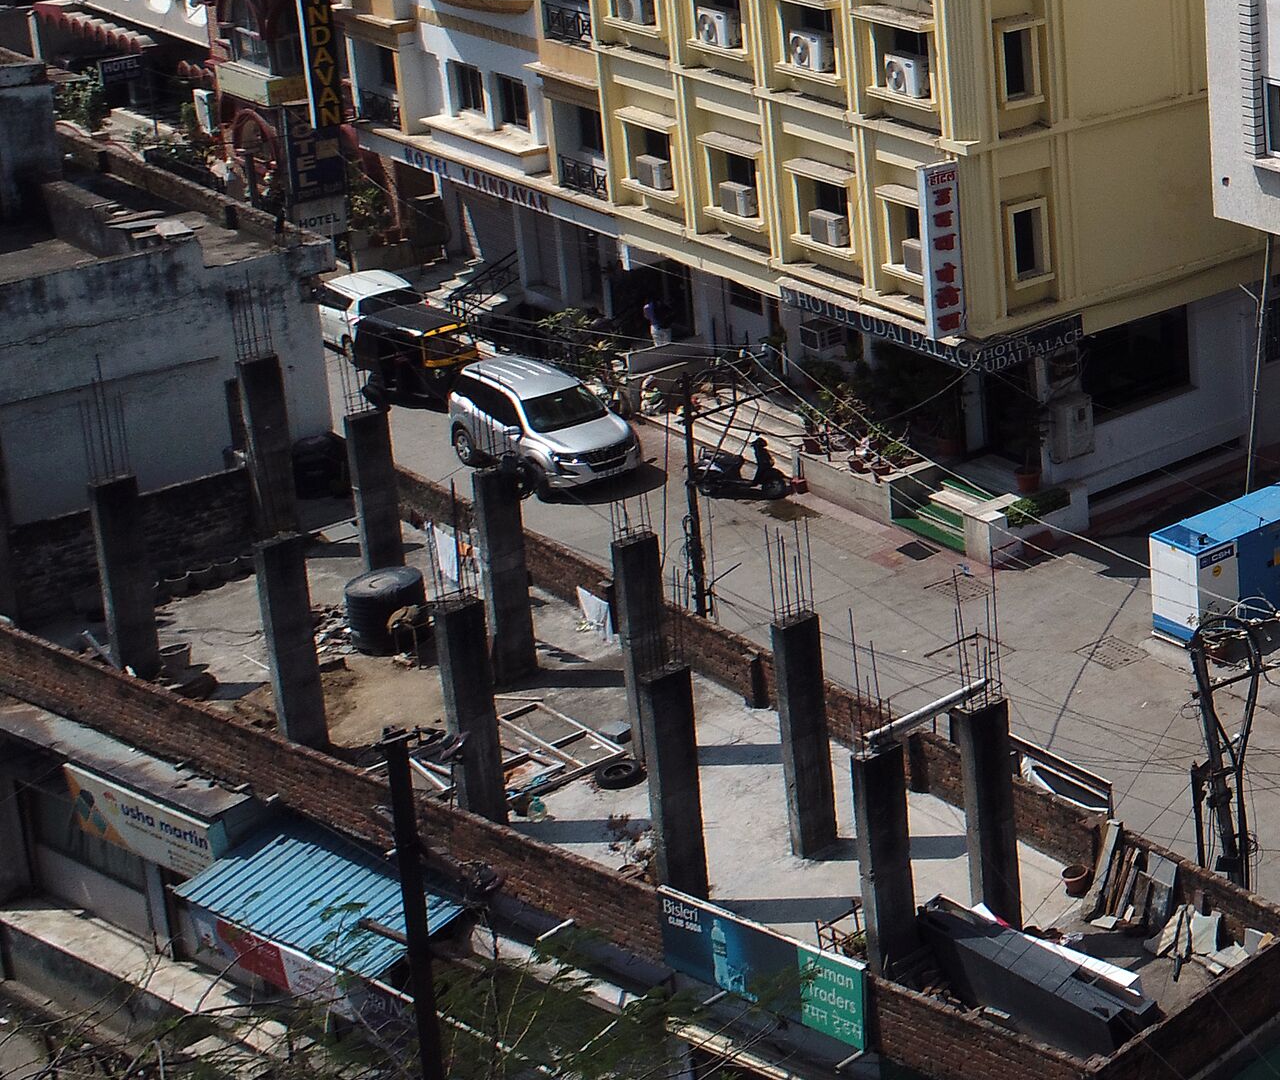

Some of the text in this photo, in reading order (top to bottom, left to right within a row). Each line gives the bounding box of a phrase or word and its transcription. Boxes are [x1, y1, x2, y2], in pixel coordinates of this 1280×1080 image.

[103, 59, 141, 73] HOTEL
[404, 147, 449, 177] HOTEL
[300, 213, 341, 229] HOTEL
[796, 291, 982, 372] HOTEL UDAI PALACE
[983, 335, 1032, 360] HOTEL
[985, 328, 1084, 373] UDAI PALACE
[120, 803, 155, 828] usha
[160, 820, 209, 851] martin
[662, 898, 698, 921] Bisleri
[806, 956, 854, 990] Raman
[808, 980, 857, 1014] Traders
